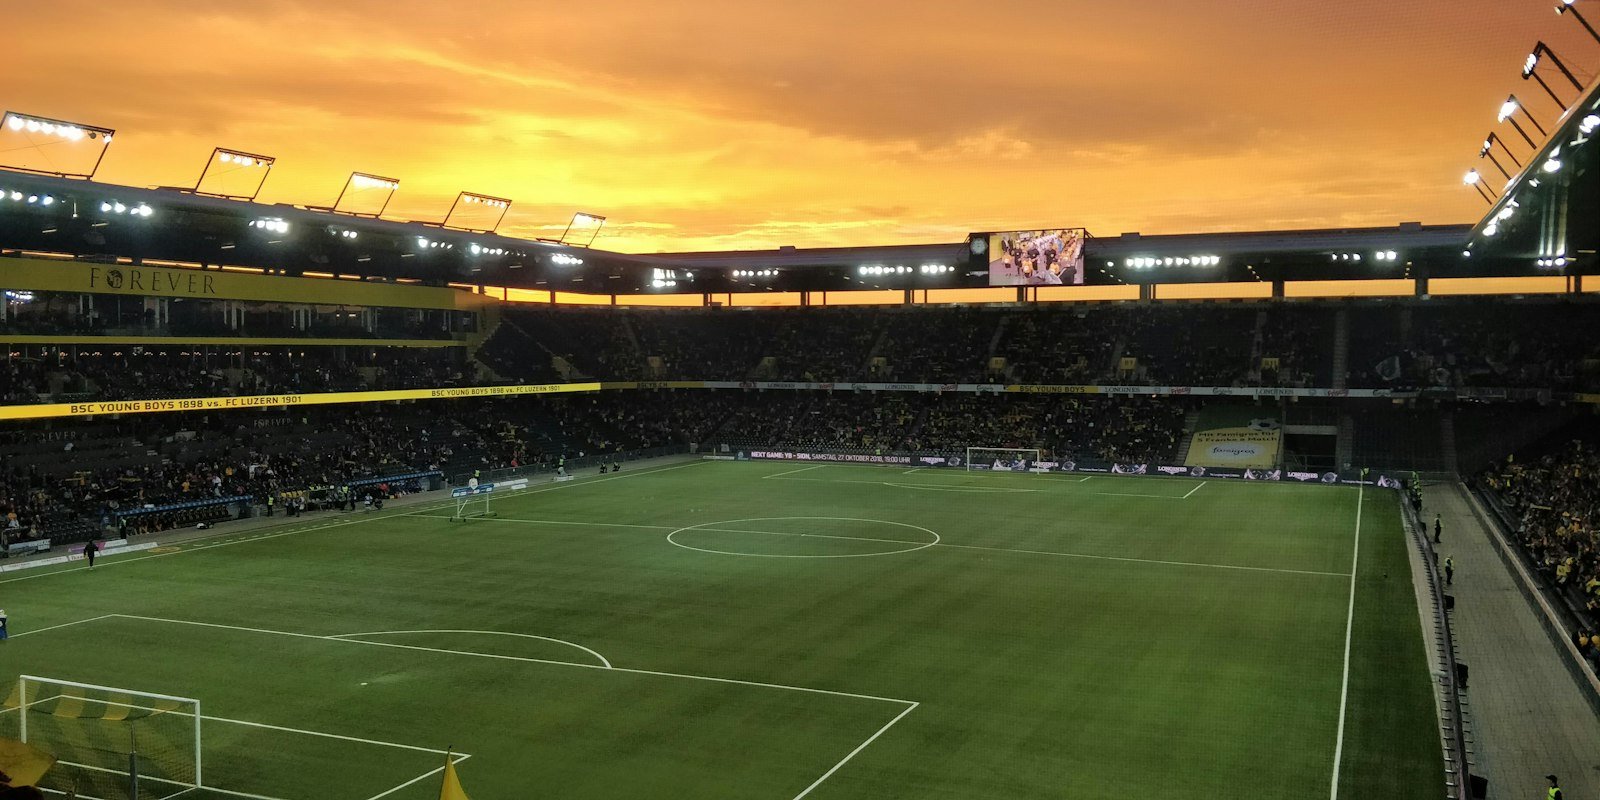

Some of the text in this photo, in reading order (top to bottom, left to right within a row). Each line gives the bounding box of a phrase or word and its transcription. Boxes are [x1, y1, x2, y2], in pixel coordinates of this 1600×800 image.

[71, 404, 94, 414] BSC
[99, 402, 140, 412] YOUNG
[145, 401, 174, 410] BOYS
[179, 400, 203, 409] 1898
[226, 398, 238, 406] FC
[241, 397, 279, 405] LUZERN
[1212, 446, 1255, 455] famigros
[766, 451, 784, 459] GAME:
[811, 453, 837, 461] SAMSTAG,
[846, 454, 870, 462] OKTOBER
[1287, 471, 1319, 479] LONGINES
